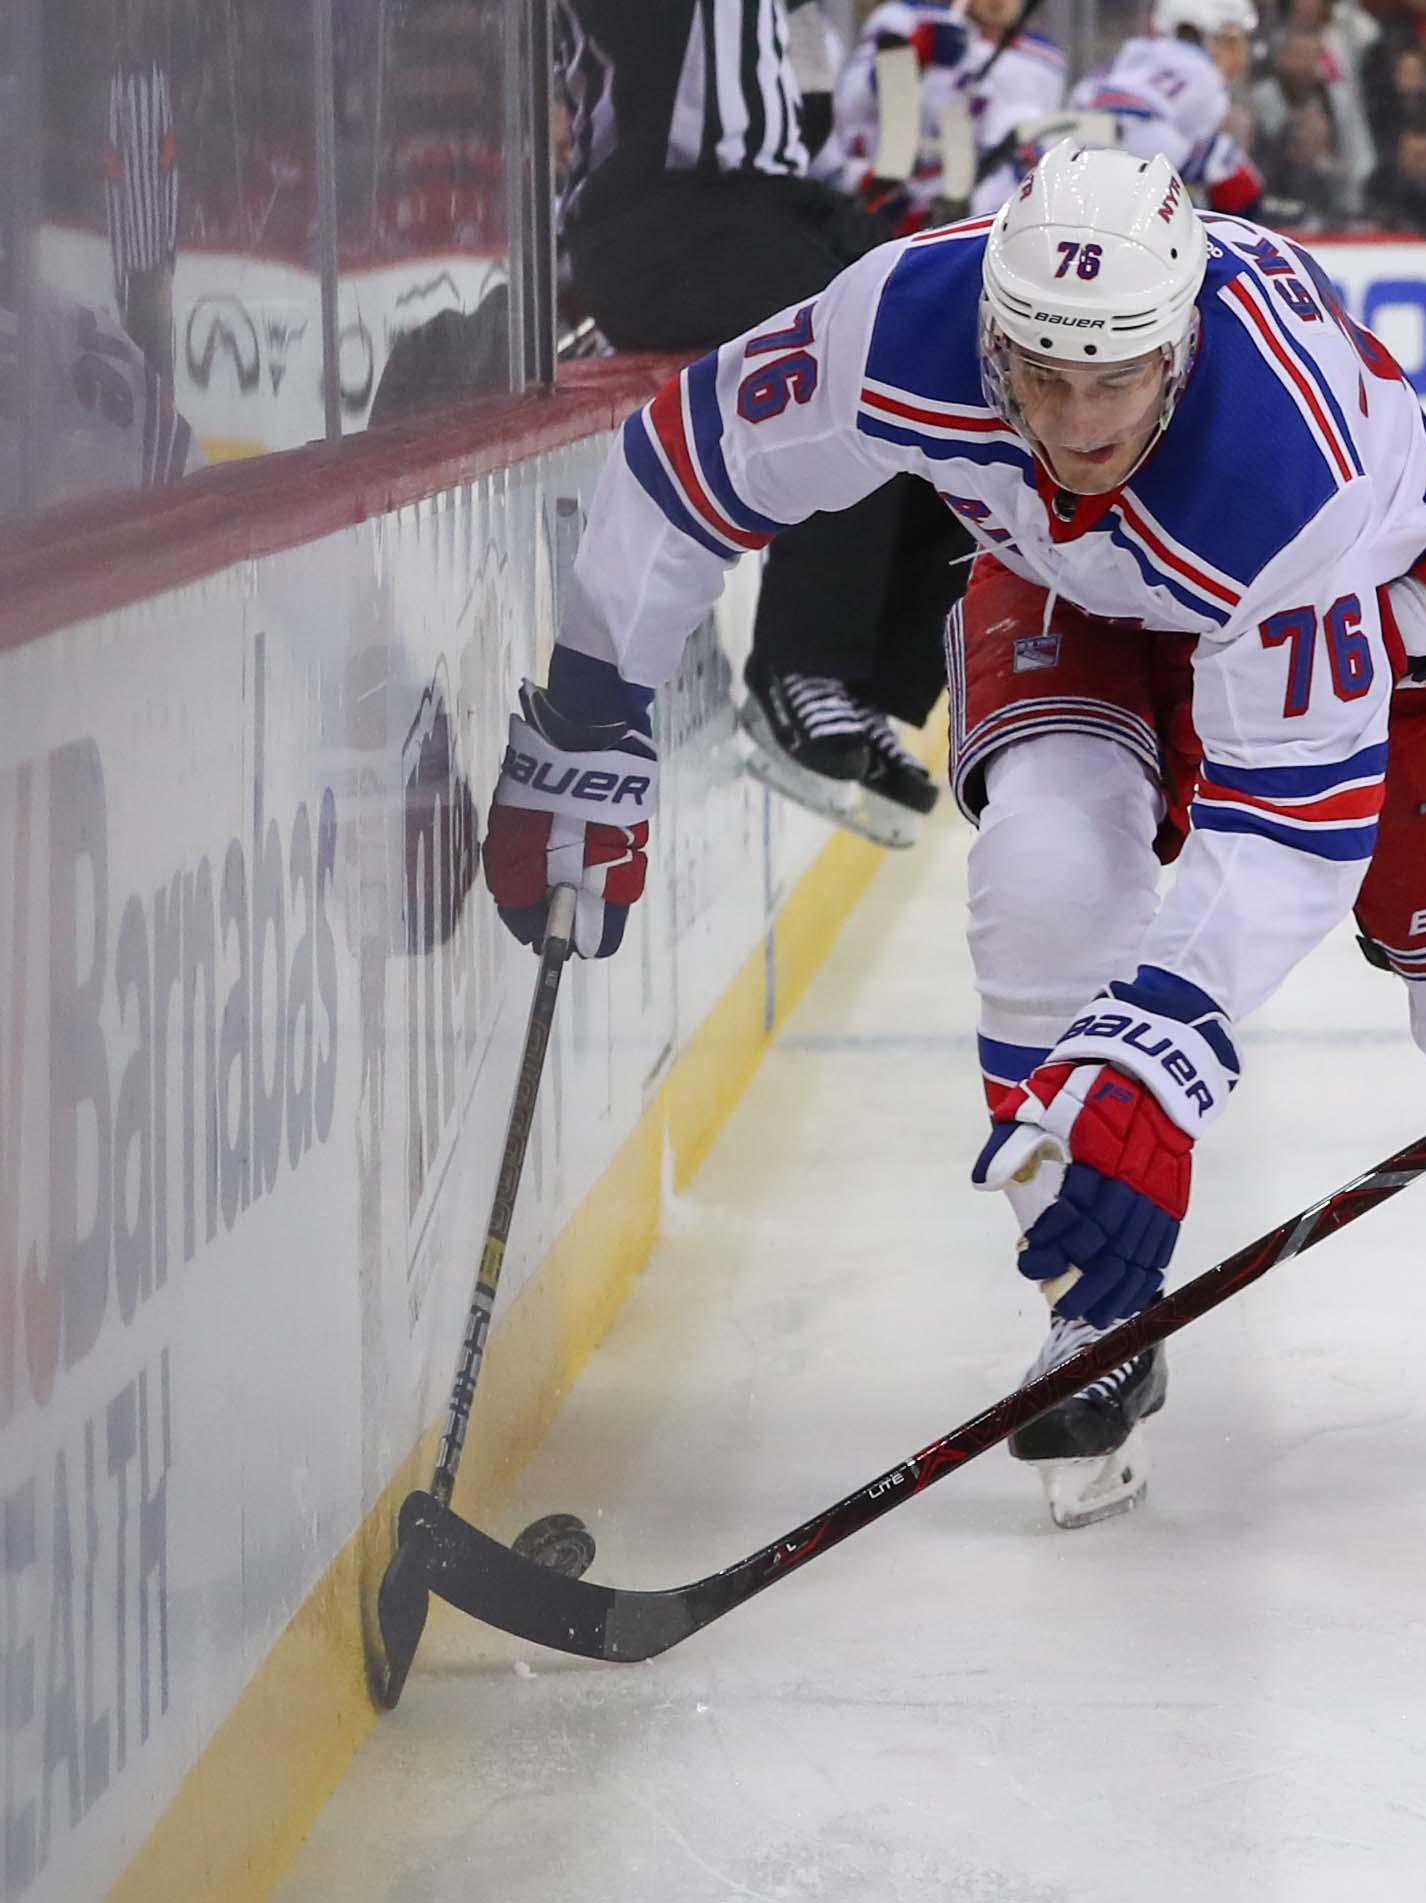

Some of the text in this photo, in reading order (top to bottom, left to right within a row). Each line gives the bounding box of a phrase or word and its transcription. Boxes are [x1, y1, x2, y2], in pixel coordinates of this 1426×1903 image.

[1158, 175, 1181, 224] NYR
[1055, 241, 1103, 281] 76
[1224, 232, 1323, 323] SK
[737, 301, 818, 424] 76
[1033, 311, 1105, 329] BAUER
[1258, 593, 1375, 718] 76
[1056, 1014, 1214, 1118] BAUER
[868, 1471, 905, 1499] LITE
[2, 1347, 170, 1897] EALTH
